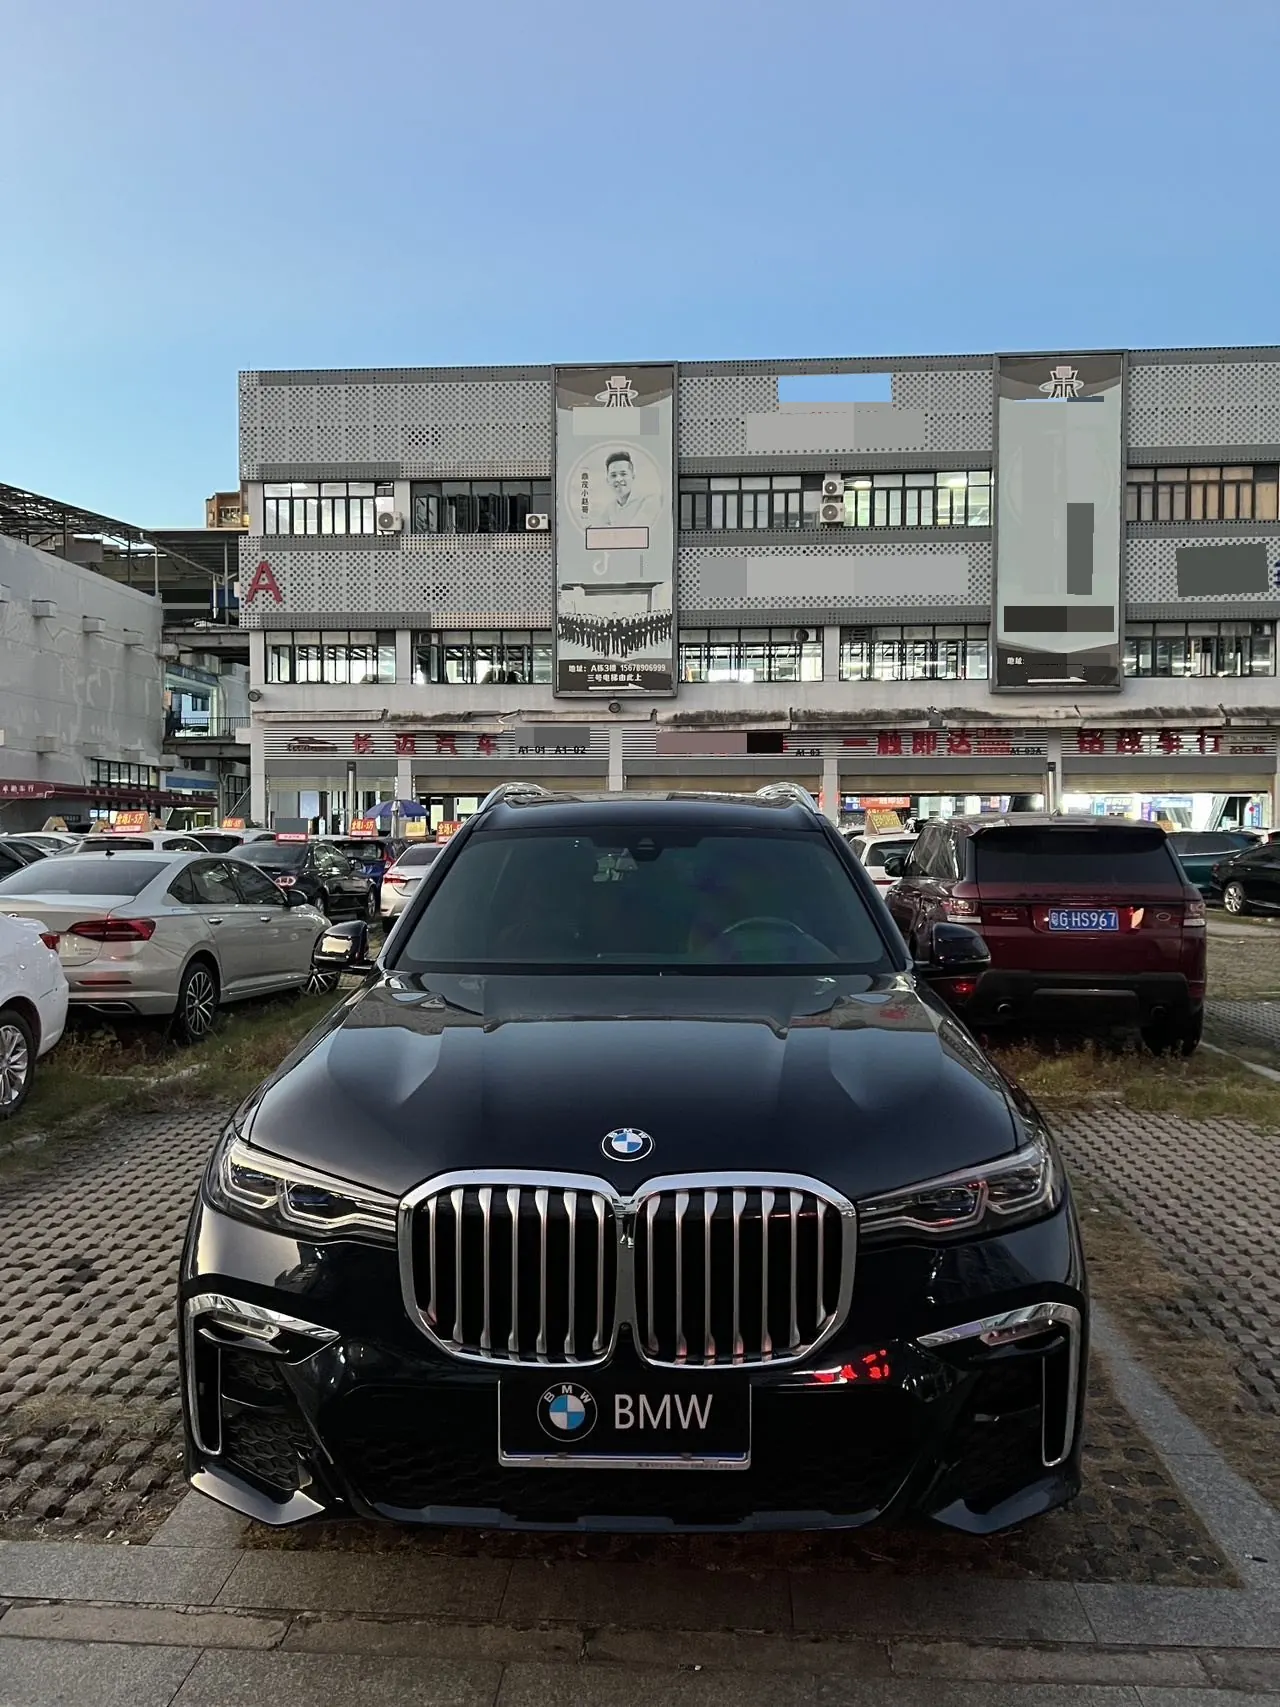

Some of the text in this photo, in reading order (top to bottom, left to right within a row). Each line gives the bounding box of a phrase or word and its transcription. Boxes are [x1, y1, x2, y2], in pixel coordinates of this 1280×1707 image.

[245, 561, 283, 604] A
[543, 1384, 592, 1404] BMW
[613, 1393, 714, 1430] BMW
